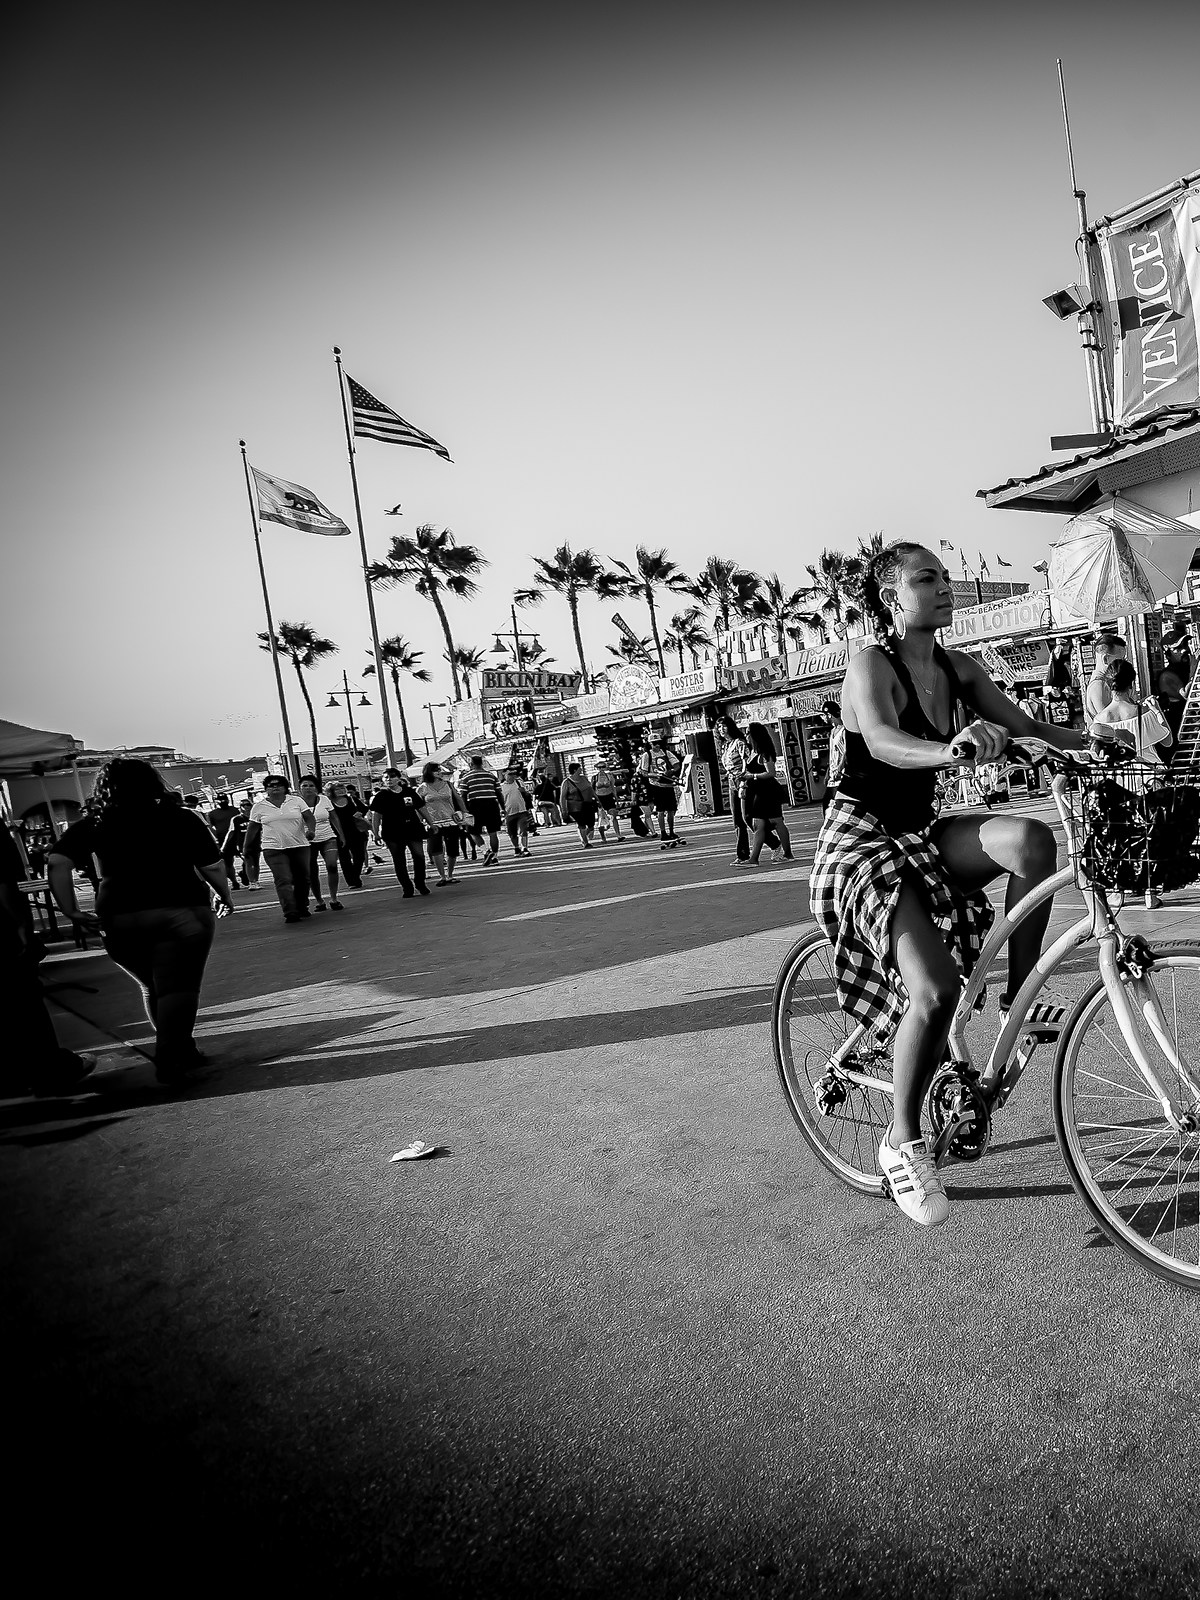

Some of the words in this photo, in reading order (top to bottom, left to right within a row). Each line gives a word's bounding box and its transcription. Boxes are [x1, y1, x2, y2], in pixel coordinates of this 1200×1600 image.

[1129, 230, 1178, 403] VENICE
[945, 617, 977, 639] SUN
[982, 602, 1043, 631] LOTION
[720, 658, 784, 691] TACOS
[795, 648, 847, 677] Henna
[484, 672, 541, 688] BIKINI
[547, 672, 580, 688] BAY
[670, 671, 704, 690] POSTERS
[306, 760, 356, 771] Sdewalk
[781, 721, 809, 802] TATTOOS
[696, 764, 709, 803] NACHOS
